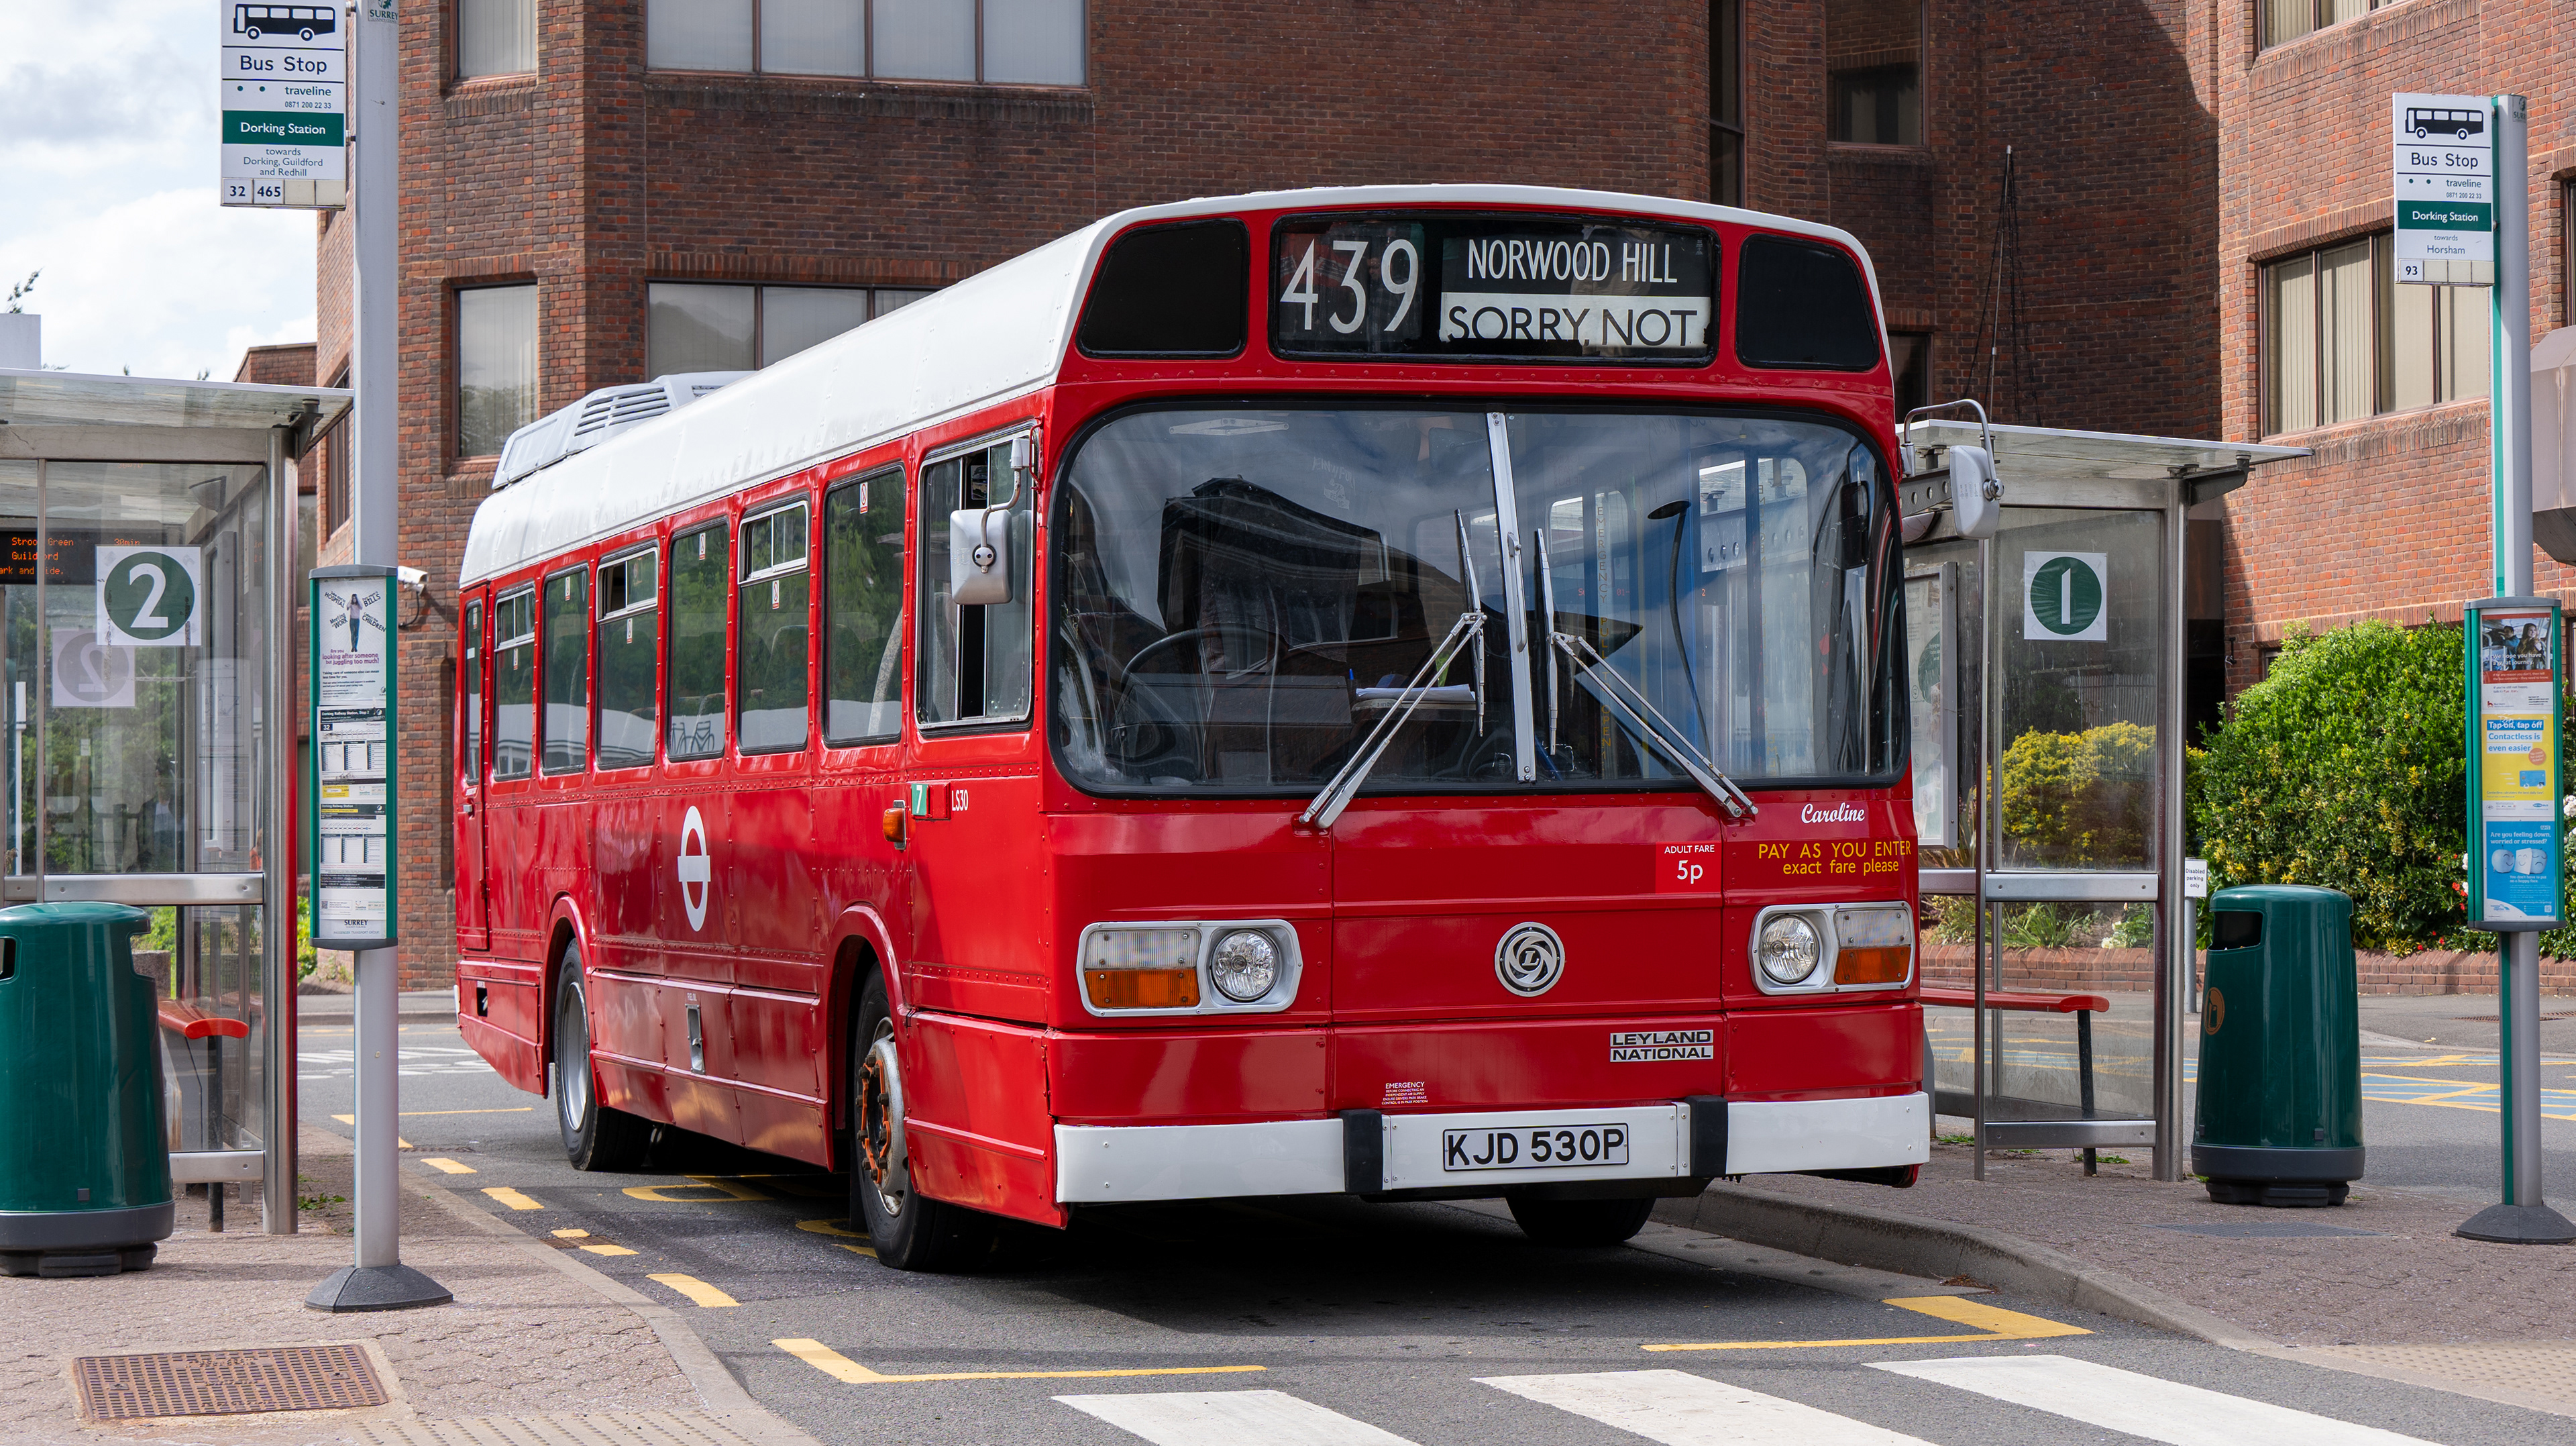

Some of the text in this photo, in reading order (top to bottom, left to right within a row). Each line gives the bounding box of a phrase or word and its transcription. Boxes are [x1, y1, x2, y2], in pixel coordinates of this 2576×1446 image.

[370, 9, 398, 20] SURREY
[240, 55, 327, 75] Bus Stop
[284, 86, 331, 97] traveline
[284, 101, 300, 109] 0871
[301, 101, 313, 109] 200
[240, 122, 326, 136] Dorking Station
[244, 157, 323, 167] Dorking, Guildford
[2411, 152, 2479, 170] Bus Stop
[260, 168, 307, 177] and Redhill
[2446, 178, 2481, 188] traveline
[229, 185, 246, 197] 32
[257, 186, 281, 197] 465
[2412, 211, 2479, 223] Dorking Station
[2427, 245, 2465, 254] Horsham
[1468, 239, 1678, 283] NORWOOD HILL
[2406, 266, 2418, 276] 93
[1280, 238, 1419, 334] 439
[1448, 305, 1699, 347] SORRY, NOT
[11, 537, 74, 546] Stroo Green
[11, 552, 59, 560] Guildord
[1596, 506, 1608, 604] EMERGENCY
[19, 566, 35, 574] and
[45, 566, 64, 574] ide.
[129, 563, 168, 628] 2
[325, 592, 345, 608] HOSPITAL
[363, 593, 381, 607] BILLS
[2061, 568, 2071, 625] 1
[333, 617, 348, 629] WORK
[362, 615, 386, 633] CHILDREN
[1600, 617, 1609, 659] PULL
[1601, 705, 1612, 747] OPEN
[2488, 721, 2502, 729] Tap
[2517, 721, 2530, 729] tap
[2531, 721, 2542, 729] off
[916, 784, 923, 814] 7
[951, 789, 969, 811] LS30
[1801, 802, 1865, 824] Caroline
[1664, 844, 1715, 854] ADULT FARE
[1758, 841, 1912, 860] PAY AS YOU ENTER
[1676, 860, 1704, 884] 5p
[1782, 858, 1900, 877] exact fare please
[1612, 1031, 1711, 1045] LEYLAND
[1612, 1045, 1712, 1061] NATIONAL
[1385, 1081, 1425, 1089] EMERGENCY
[1448, 1128, 1625, 1168] KJD 530P
